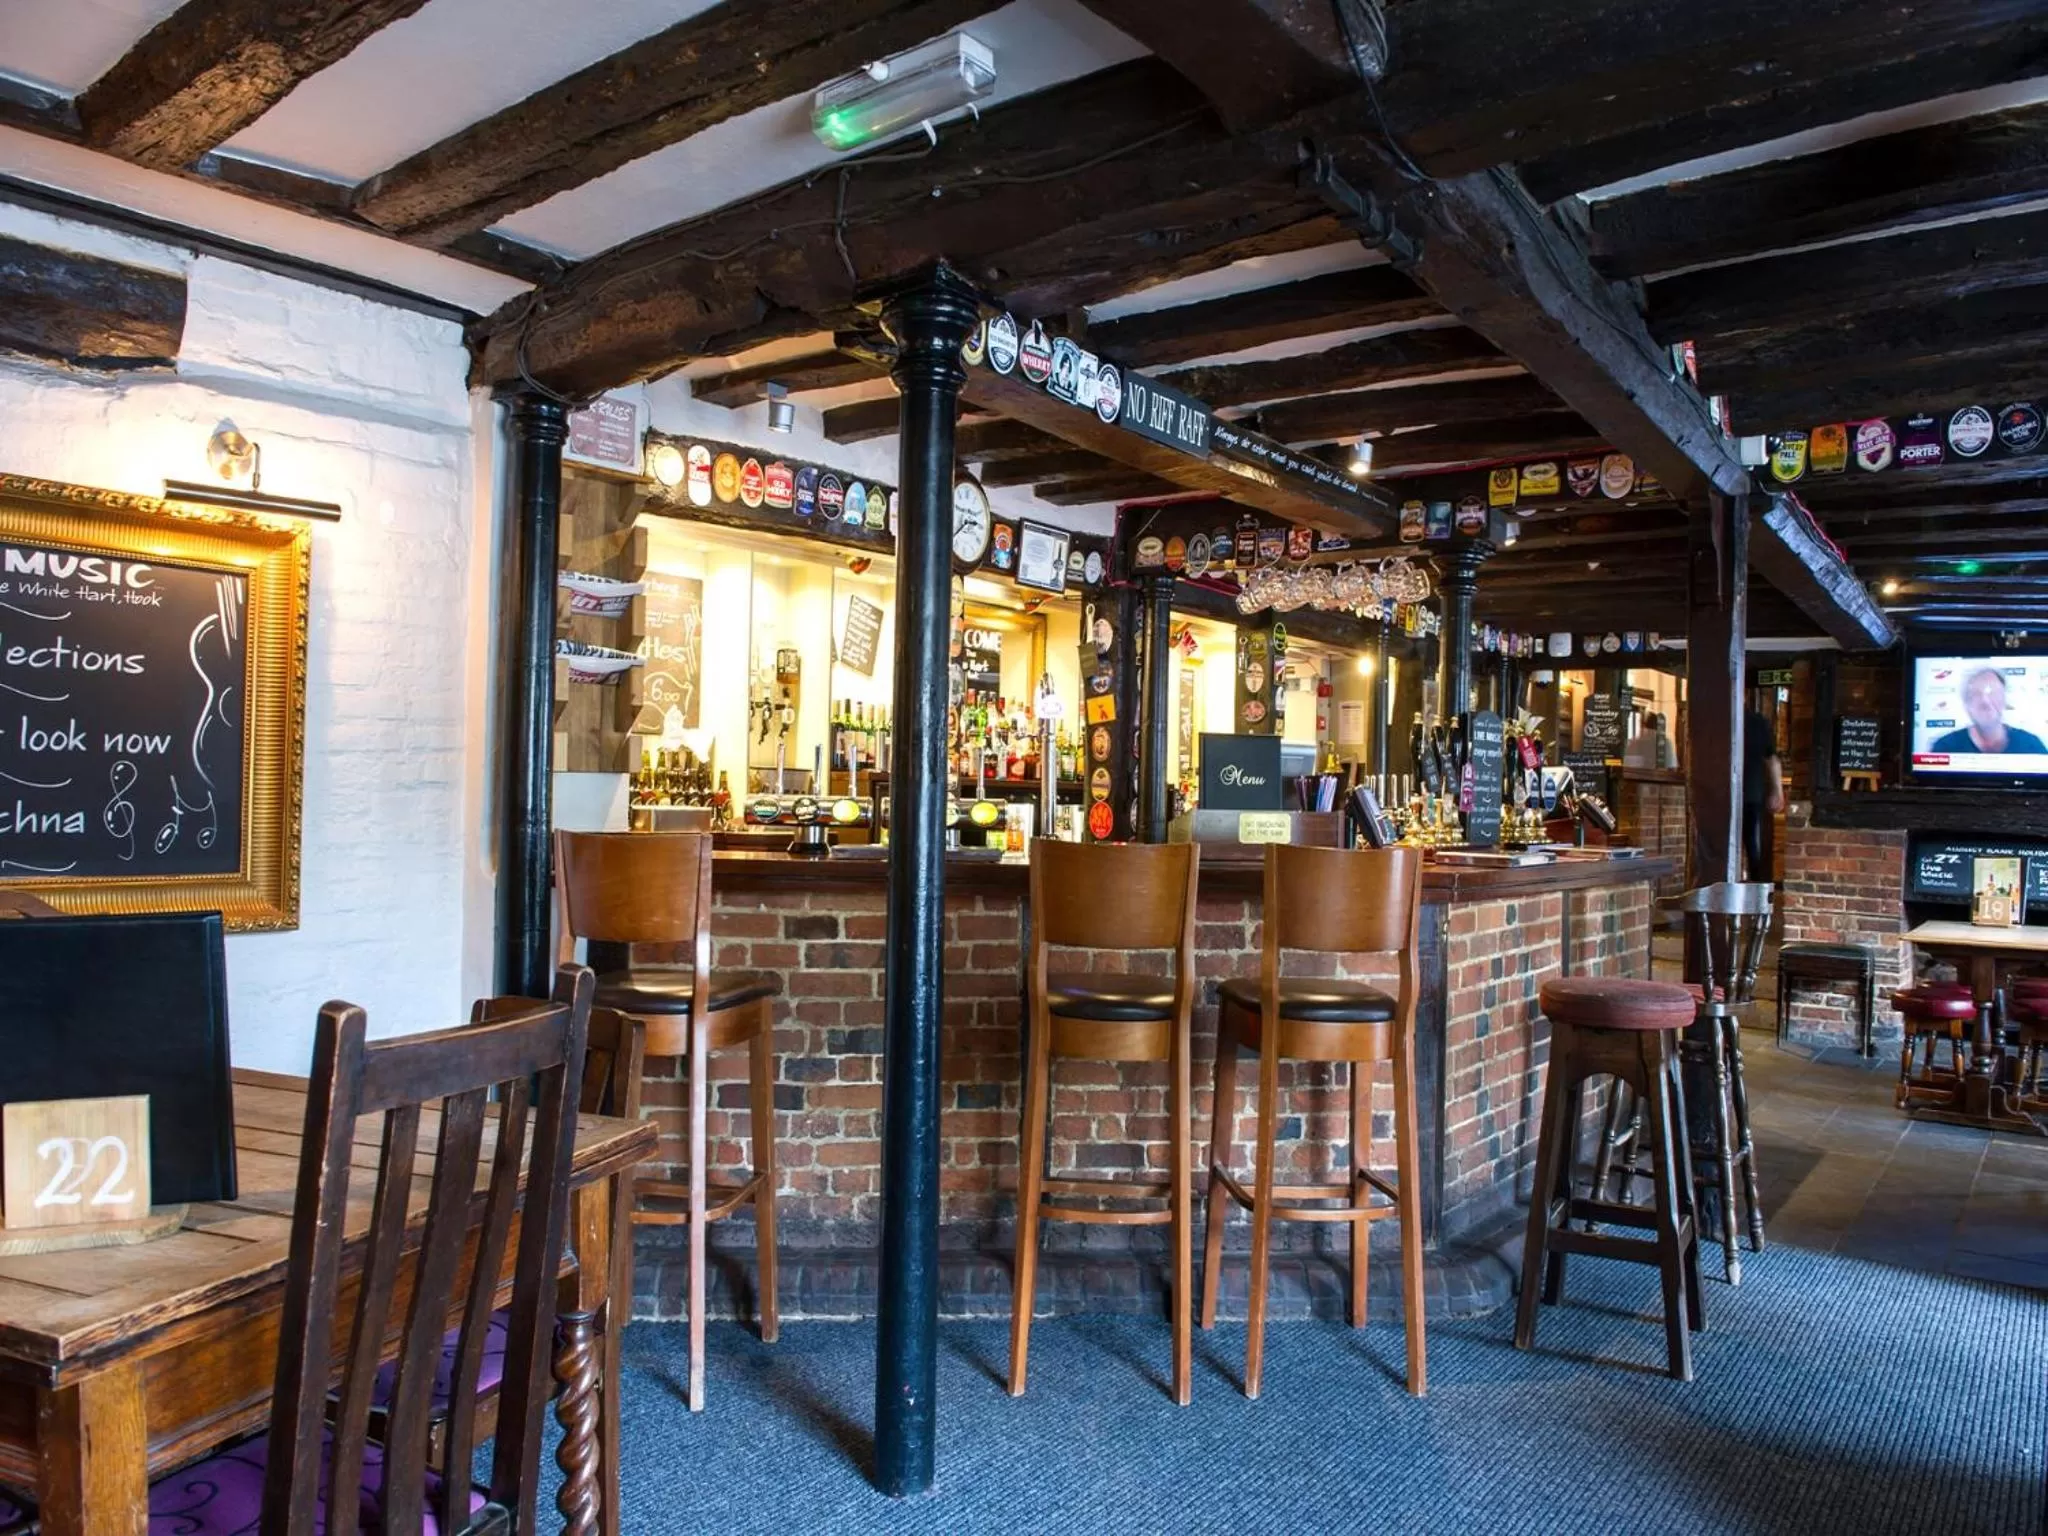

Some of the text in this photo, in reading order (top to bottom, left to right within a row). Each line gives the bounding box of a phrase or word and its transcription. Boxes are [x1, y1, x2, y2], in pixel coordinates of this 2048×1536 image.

[1126, 382, 1206, 447] NO RIFF RAFF
[1900, 446, 1941, 459] PORTER
[5, 548, 155, 589] MUSIC
[18, 582, 70, 599] White
[123, 590, 163, 606] Hook
[20, 715, 172, 754] look now
[1221, 764, 1266, 787] Menu
[1981, 899, 2004, 921] 18
[34, 1135, 136, 1209] 22
